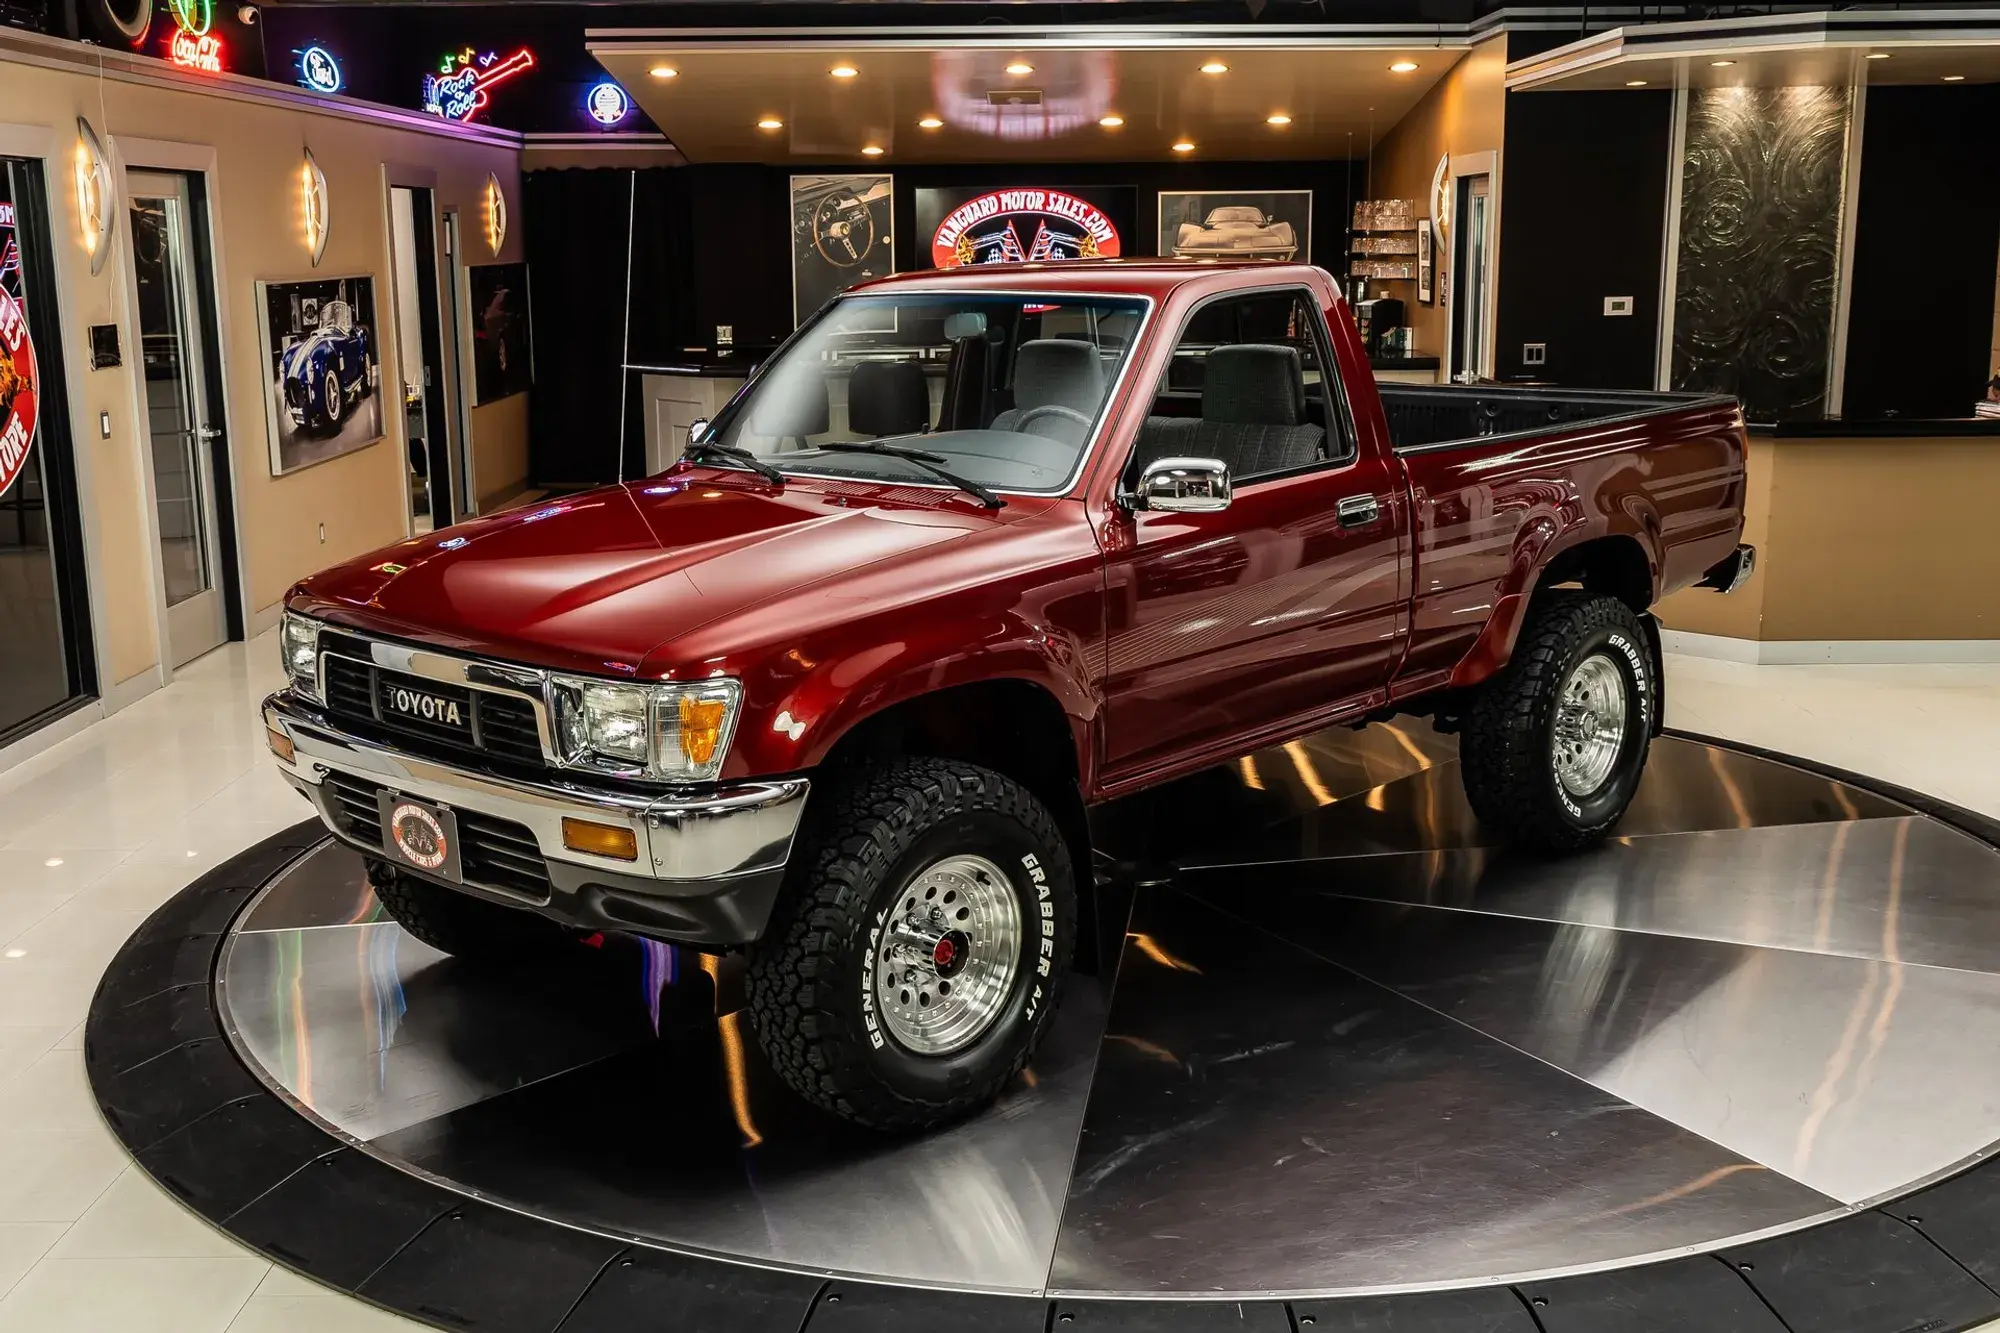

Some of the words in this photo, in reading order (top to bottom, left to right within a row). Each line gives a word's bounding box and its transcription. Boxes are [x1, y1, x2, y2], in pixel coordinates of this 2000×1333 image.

[440, 70, 475, 98] Rock
[446, 90, 476, 118] Roll
[937, 195, 998, 248] VANGUARD
[999, 191, 1045, 212] MOTOR
[1046, 192, 1114, 243] SALES.COM
[1608, 634, 1646, 692] GRABBER
[386, 685, 462, 725] TOYOTA
[1020, 852, 1054, 978] GRABBER
[862, 908, 888, 1050] GENERAL
[1025, 984, 1044, 1021] A/T
